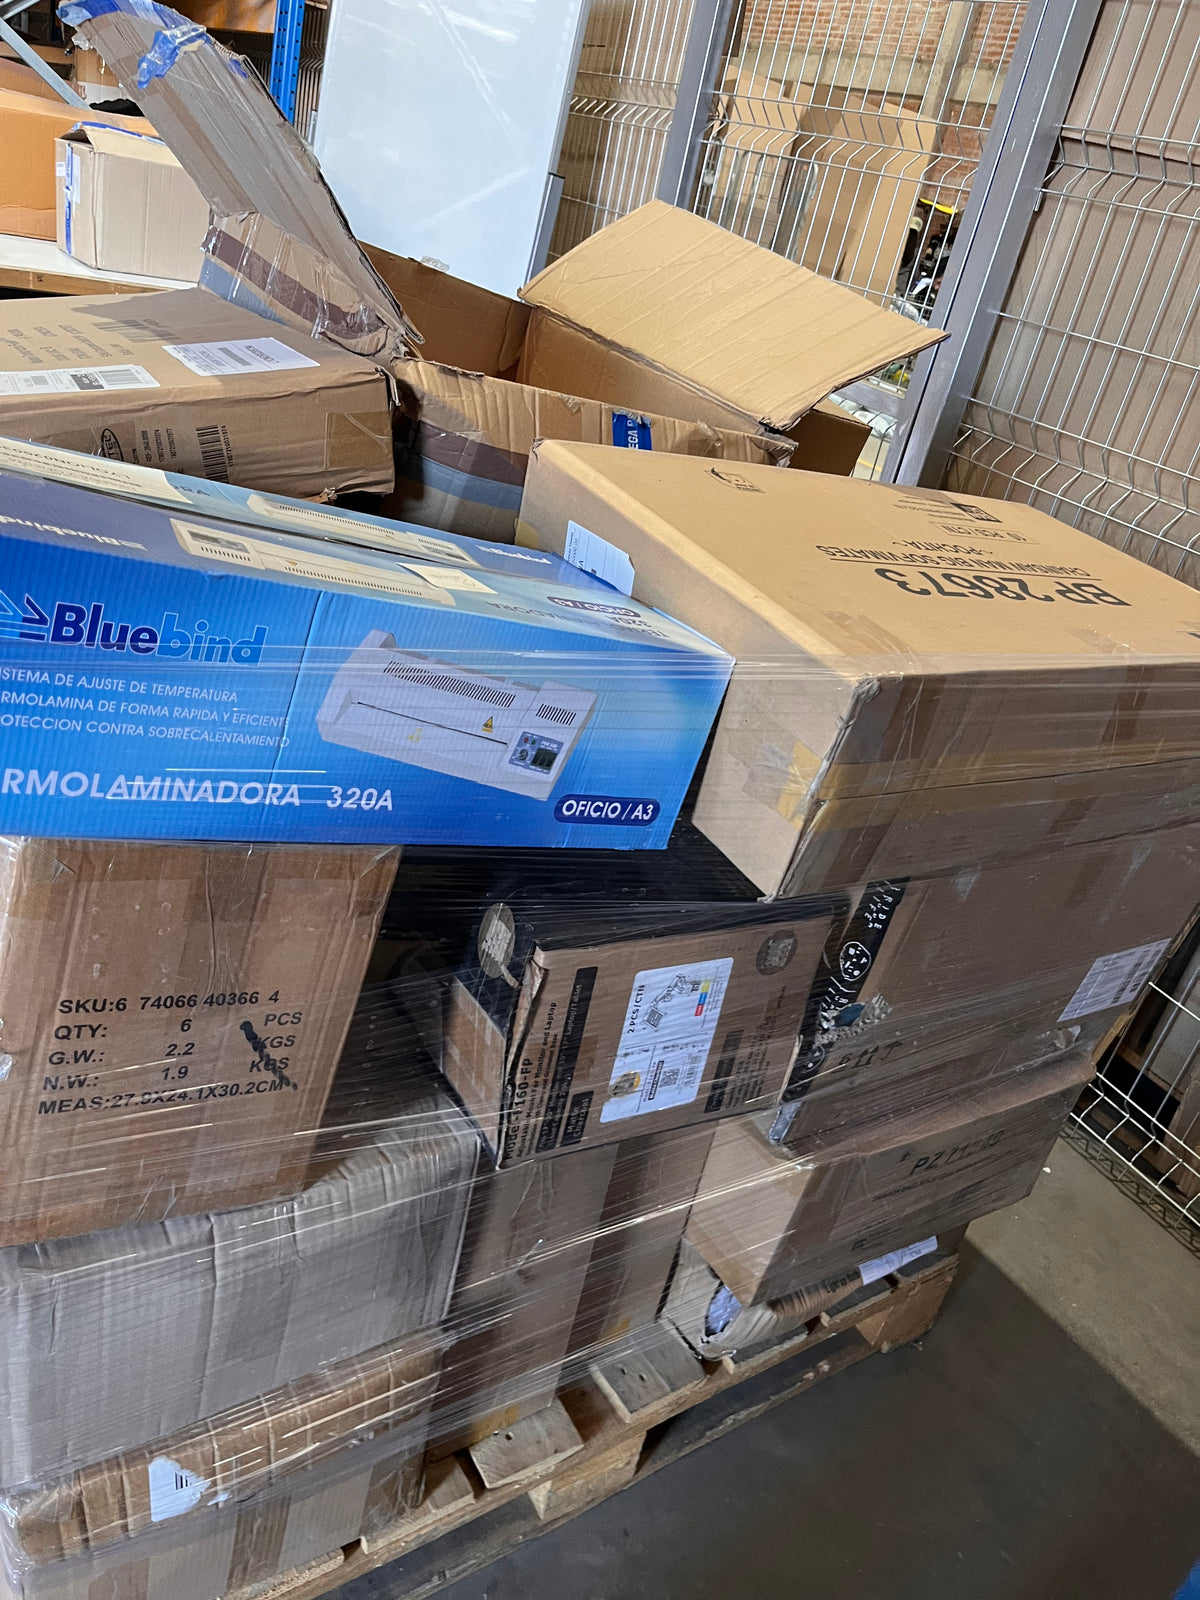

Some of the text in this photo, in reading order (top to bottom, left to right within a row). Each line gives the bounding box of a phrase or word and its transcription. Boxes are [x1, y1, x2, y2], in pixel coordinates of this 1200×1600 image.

[938, 554, 969, 570] BIG
[972, 556, 1008, 573] MAN
[1008, 558, 1091, 577] CHAINSAW
[874, 568, 1132, 606] BP 28673
[50, 601, 270, 668] Bluebind
[54, 673, 74, 687] DE
[77, 676, 126, 693] AJUSTE
[130, 681, 148, 694] DE
[151, 682, 238, 703] TEMPERATURA
[98, 700, 116, 713] DE
[120, 702, 170, 718] FORMA
[172, 706, 219, 722] RAPIDA
[221, 710, 230, 723] Y
[86, 720, 144, 738] CONTRA
[148, 726, 291, 748] SOBRECALENTAMIENTO
[326, 785, 394, 812] 320A
[562, 799, 622, 820] OFICIO
[632, 803, 655, 822] A3
[58, 990, 280, 1015] SKU:6 74066 40366 4
[54, 1011, 304, 1041] QTY: 6 PCS
[545, 1002, 558, 1032] Laptop
[48, 1048, 106, 1066] G.W.:
[165, 1042, 196, 1058] 2.2
[43, 1074, 100, 1092] N.W.:
[162, 1066, 189, 1082] 1.9
